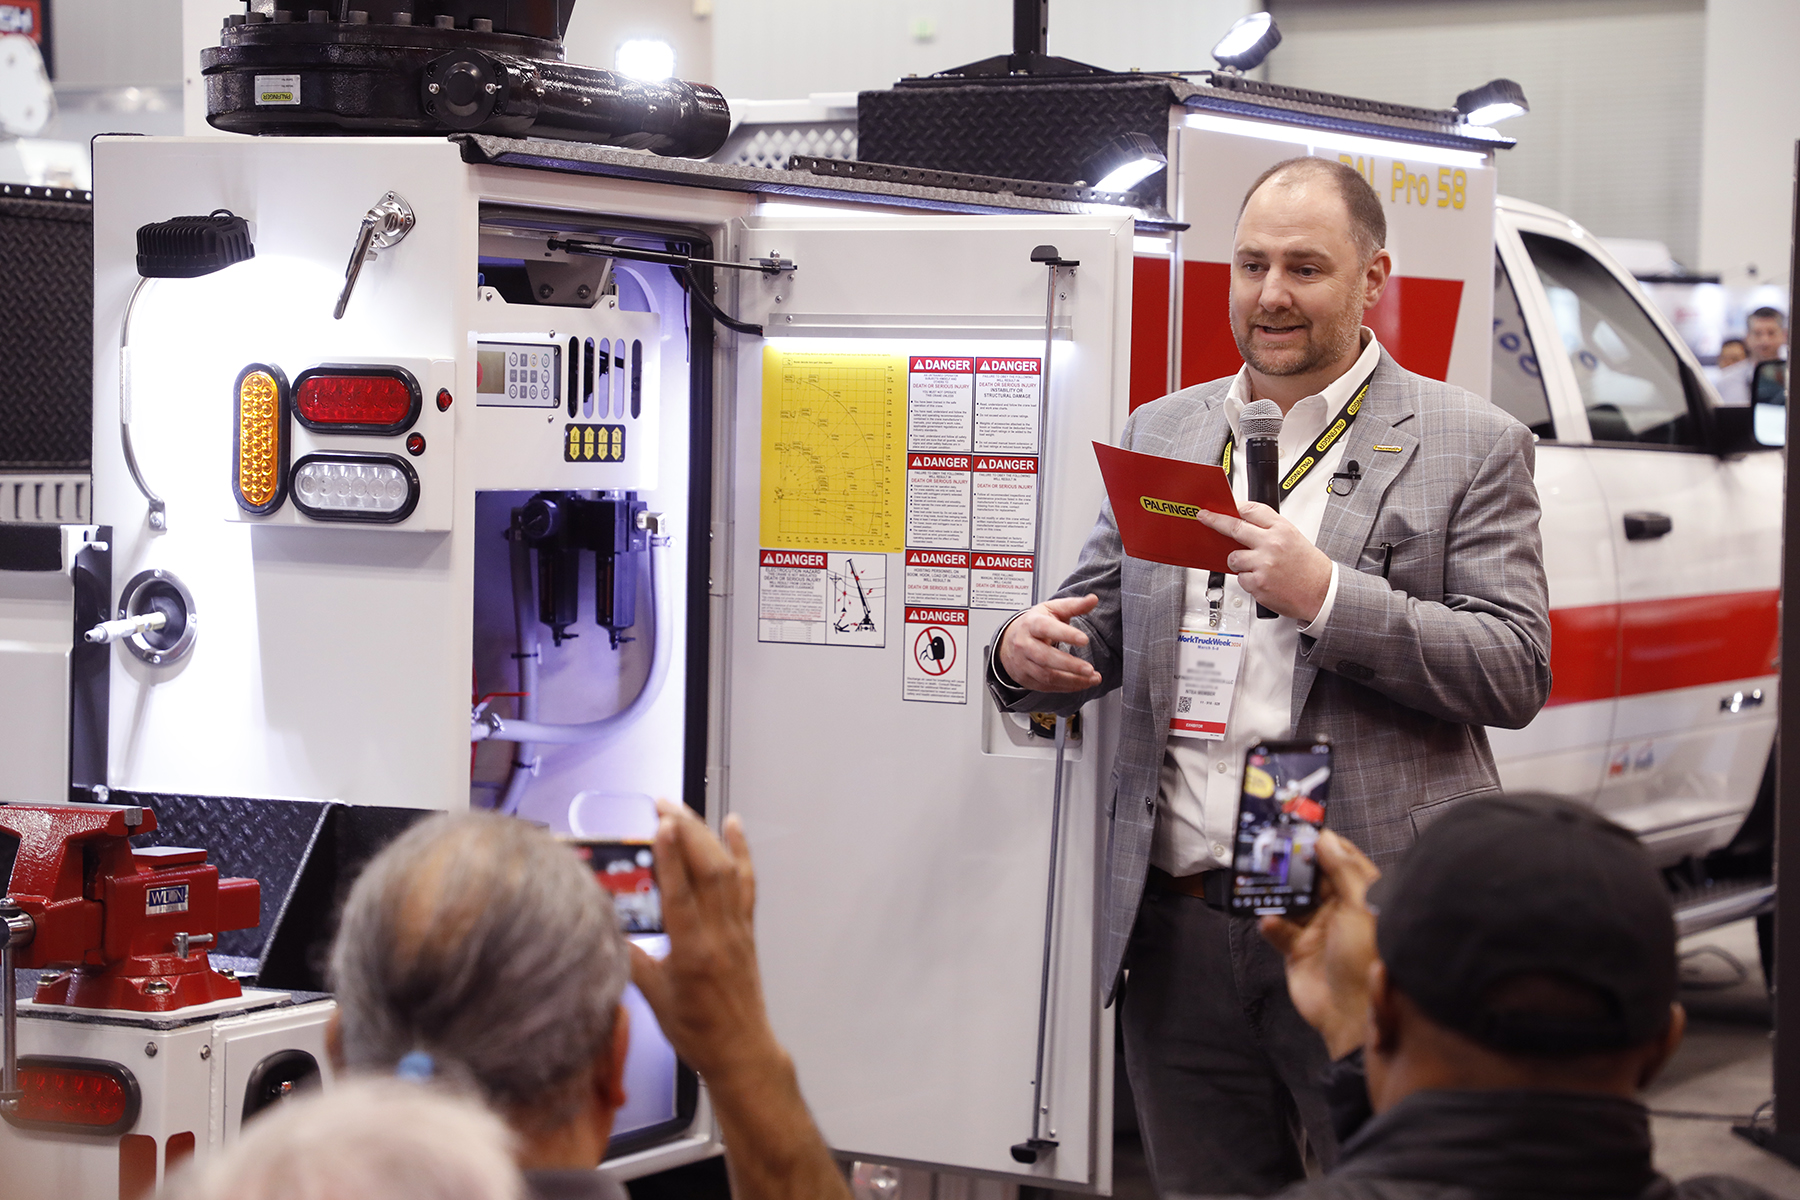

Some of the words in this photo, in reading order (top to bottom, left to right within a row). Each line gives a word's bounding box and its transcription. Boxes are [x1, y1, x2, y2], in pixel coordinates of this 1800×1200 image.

[1391, 161, 1430, 205] Pro
[1438, 166, 1466, 210] 58
[925, 360, 970, 371] DANGER
[992, 360, 1037, 371] DANGER
[1318, 420, 1344, 450] PALFINGER
[923, 456, 968, 468] DANGER
[989, 459, 1034, 470] DANGER
[1284, 458, 1312, 488] PALFINGER
[1143, 498, 1200, 517] PALFINGER
[776, 554, 824, 566] DANGER
[921, 553, 966, 564] DANGER
[987, 556, 1032, 568] DANGER
[920, 610, 965, 622] DANGER
